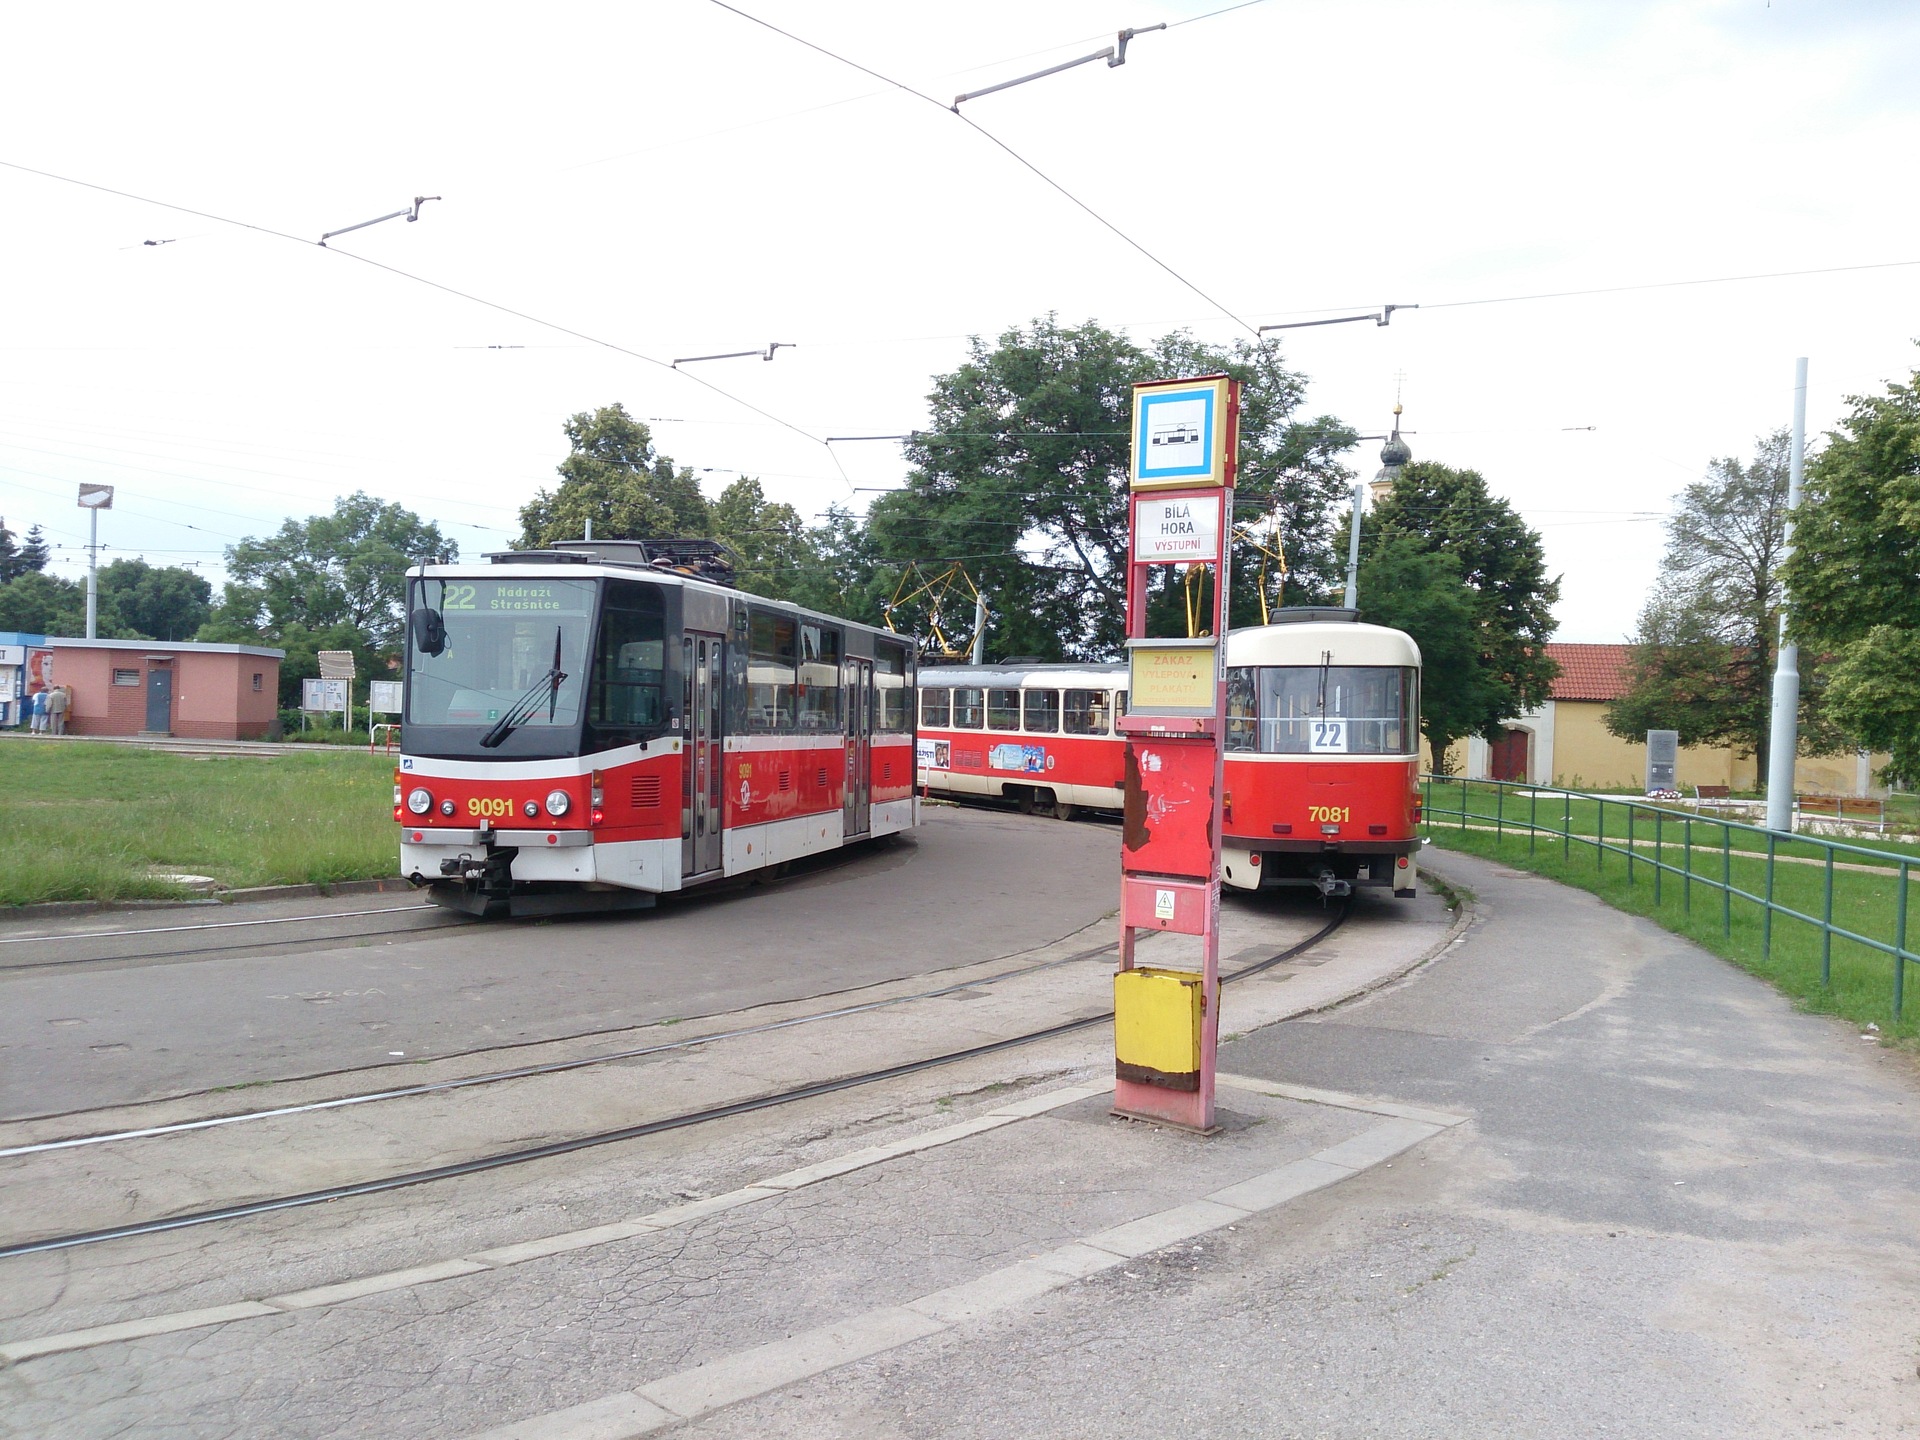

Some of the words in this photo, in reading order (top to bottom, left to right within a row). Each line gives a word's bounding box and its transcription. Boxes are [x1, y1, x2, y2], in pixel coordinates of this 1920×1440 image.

[1165, 503, 1190, 519] BÍLÁ
[1161, 521, 1194, 535] HORA
[1155, 537, 1201, 551] VÝSTUPNÍ
[444, 585, 476, 609] 22
[497, 586, 552, 597] Nádraží
[490, 598, 560, 610] Strašnice
[1154, 654, 1192, 665] ZÁKAZ
[1150, 682, 1196, 693] PLAKÁTŮ
[1315, 723, 1342, 747] 22
[738, 763, 752, 779] 9091
[468, 798, 514, 817] 9091
[1308, 806, 1350, 823] 7081
